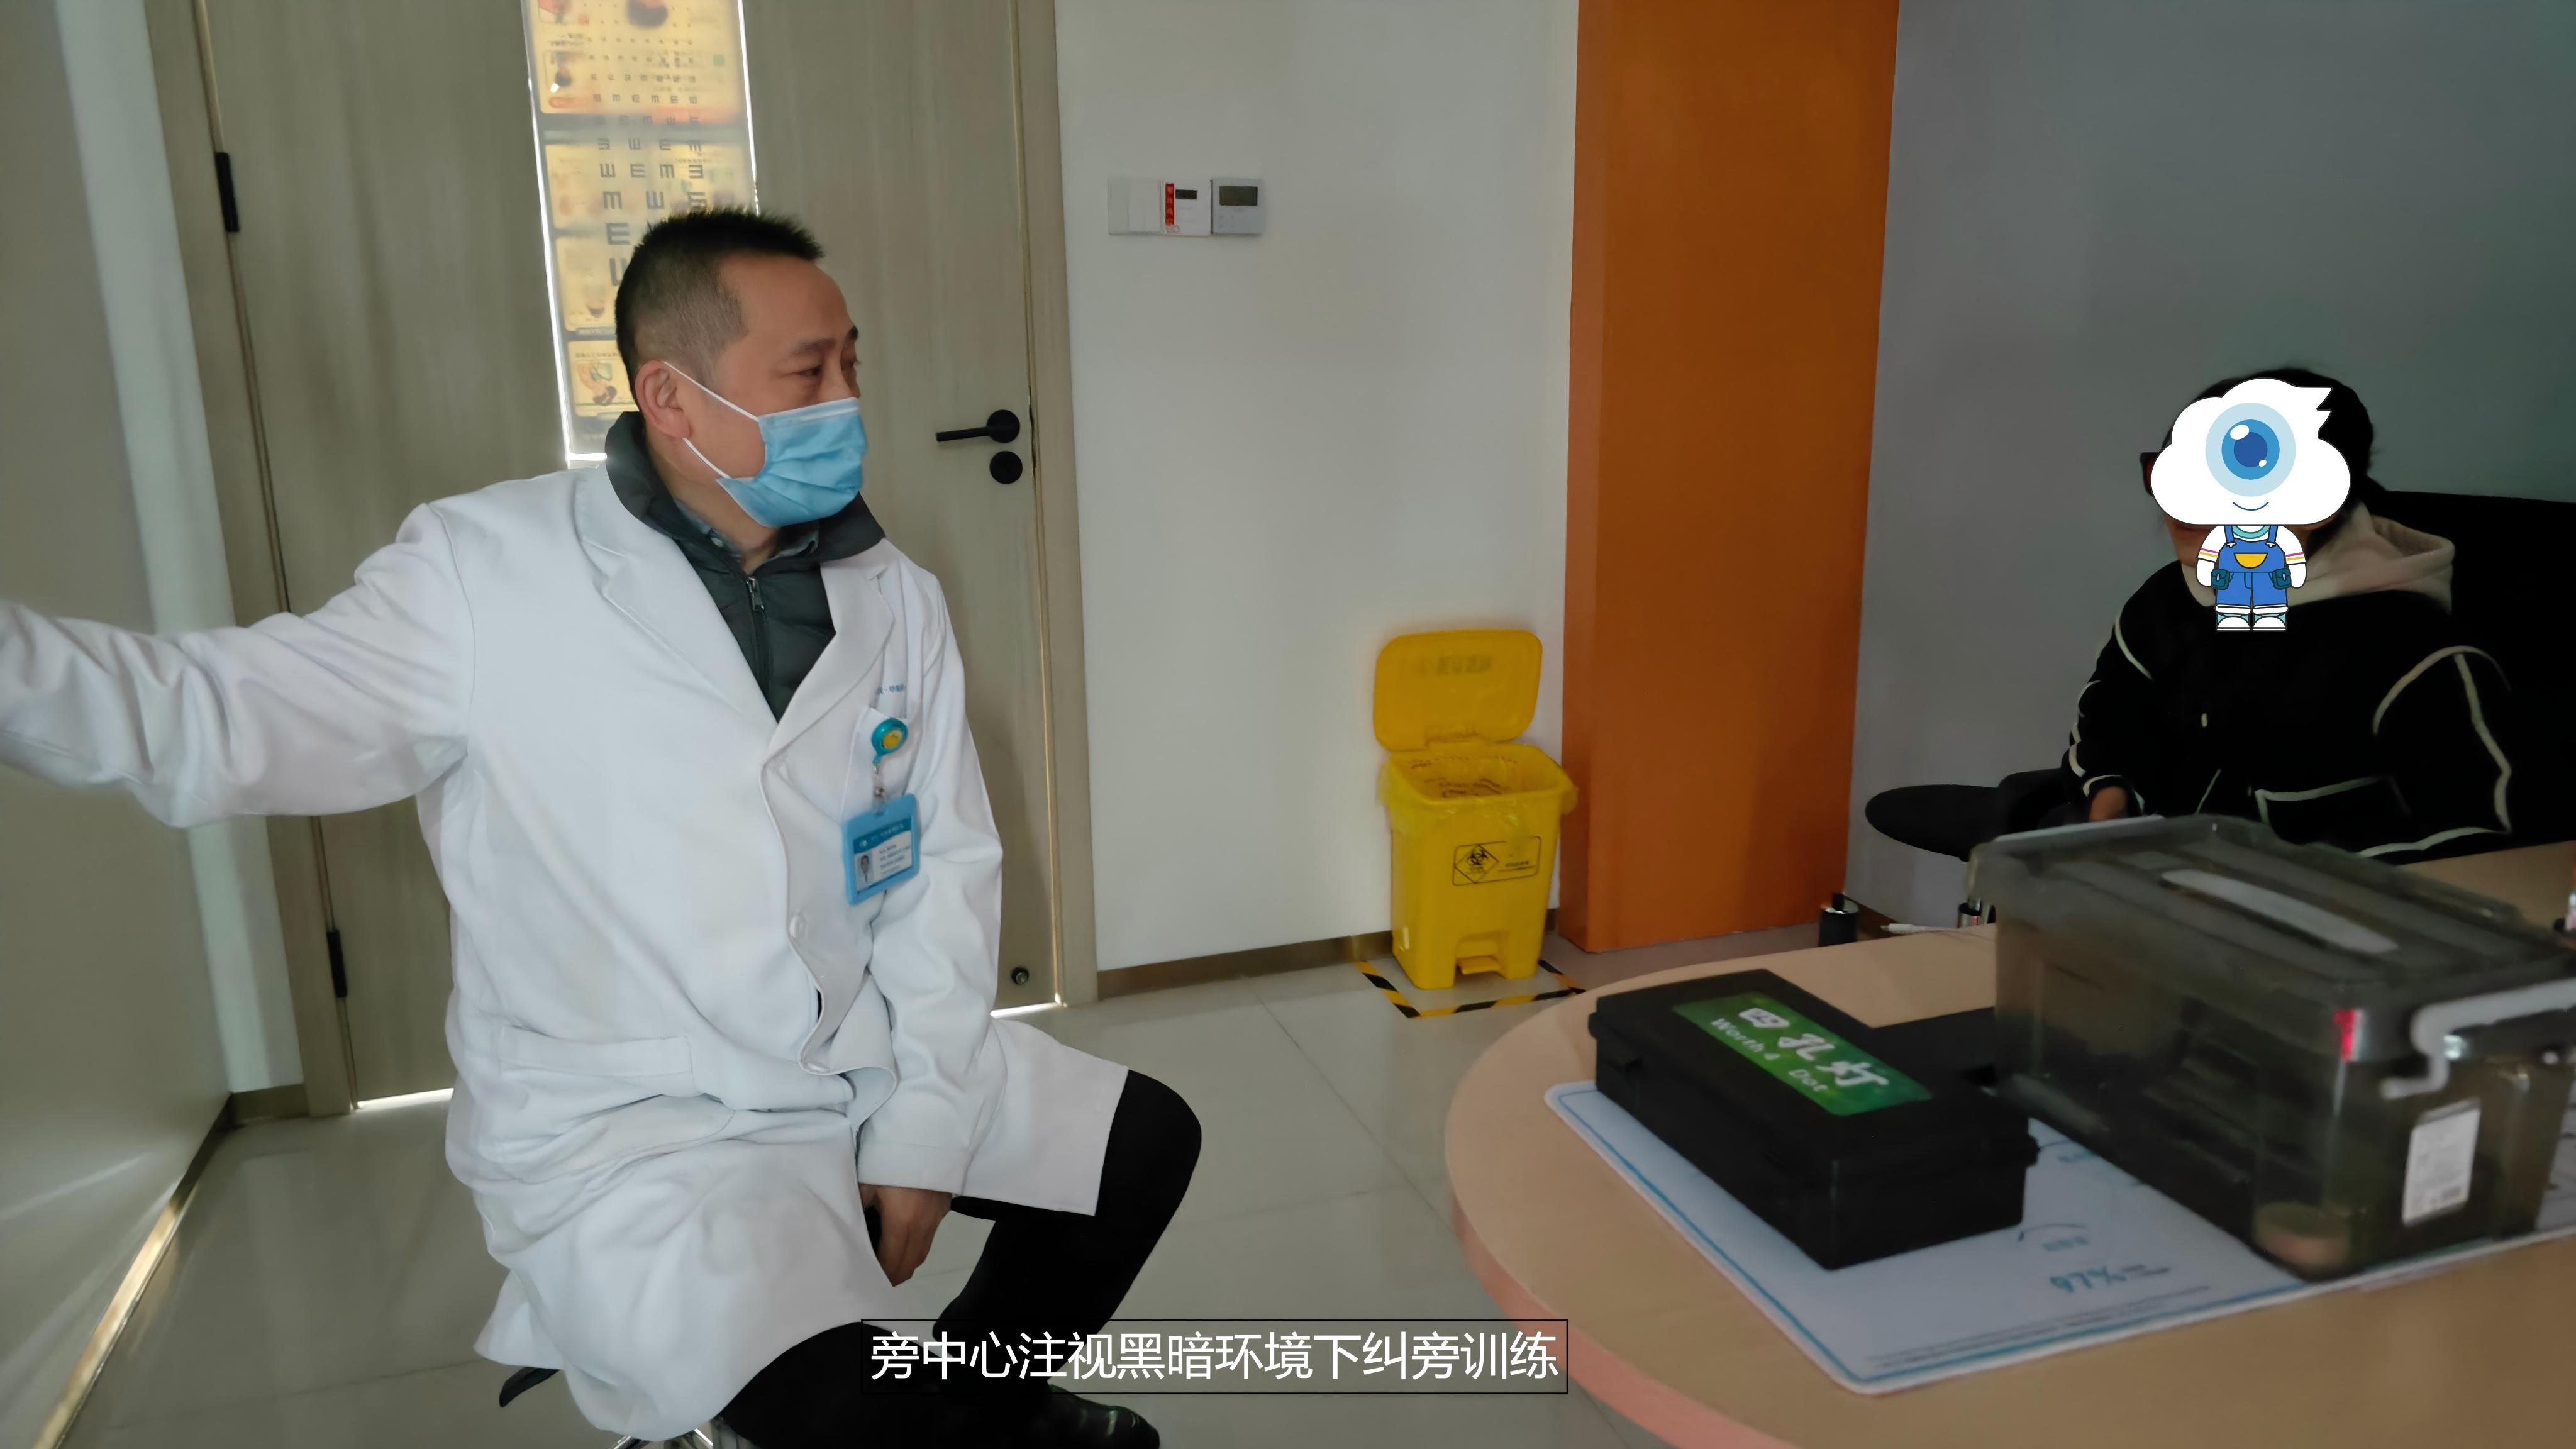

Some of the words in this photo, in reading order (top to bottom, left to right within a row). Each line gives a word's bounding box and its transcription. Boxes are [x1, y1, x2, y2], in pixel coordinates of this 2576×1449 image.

[1711, 1018, 1765, 1053] Worth
[1788, 1069, 1828, 1092] Dot
[1738, 1008, 1889, 1087] 四孔灯
